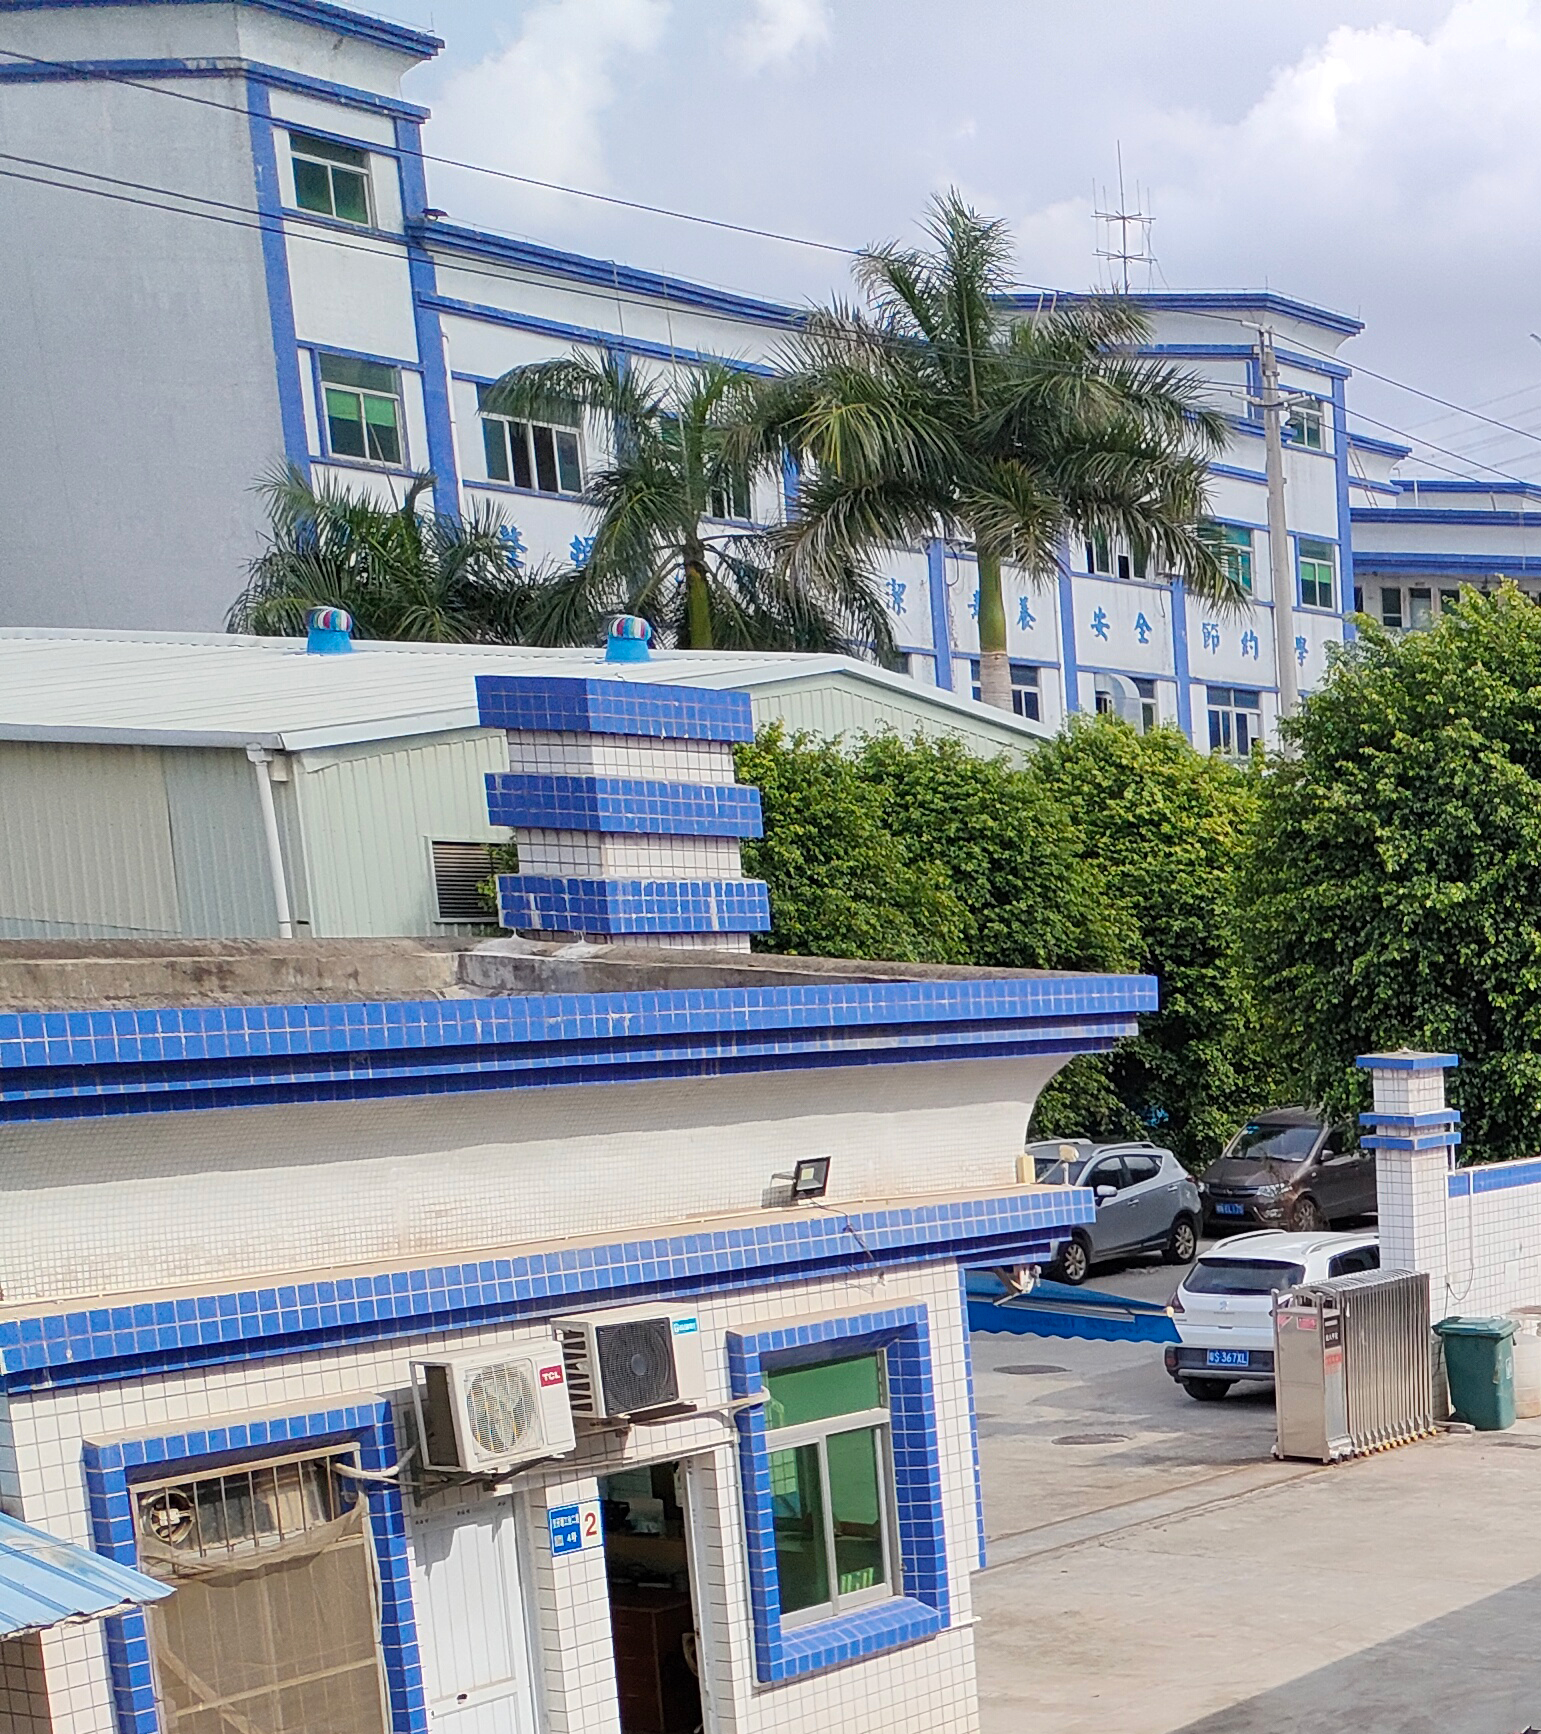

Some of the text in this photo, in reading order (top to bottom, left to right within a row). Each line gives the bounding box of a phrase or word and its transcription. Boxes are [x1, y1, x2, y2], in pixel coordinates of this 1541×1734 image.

[1090, 606, 1152, 645] 安全
[1201, 621, 1260, 661] 節約
[541, 1371, 561, 1382] TCL
[584, 1512, 598, 1537] 2
